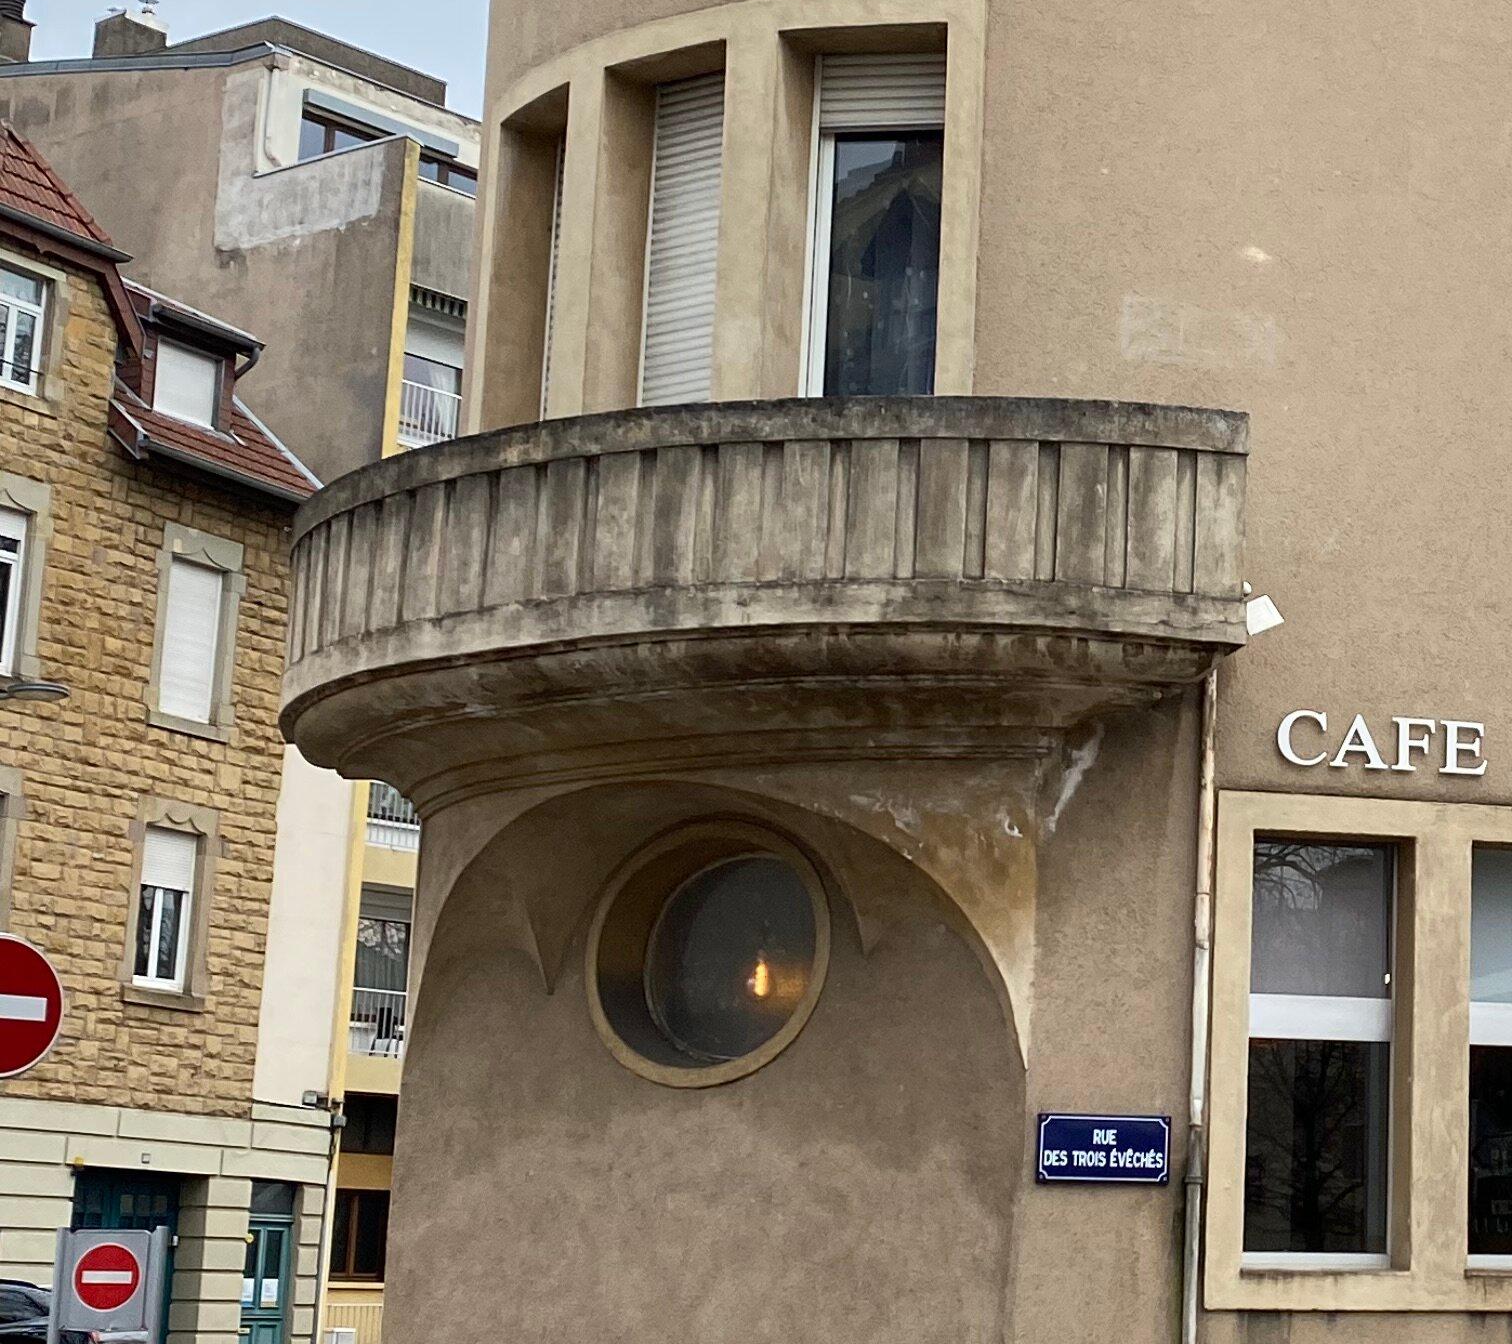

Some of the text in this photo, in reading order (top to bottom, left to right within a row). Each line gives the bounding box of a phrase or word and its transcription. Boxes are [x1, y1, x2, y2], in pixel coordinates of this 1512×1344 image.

[1276, 709, 1488, 776] CAFE
[1093, 1129, 1117, 1145] RUE
[1043, 1148, 1164, 1168] DES TROIS ÉVÊCHÉS
